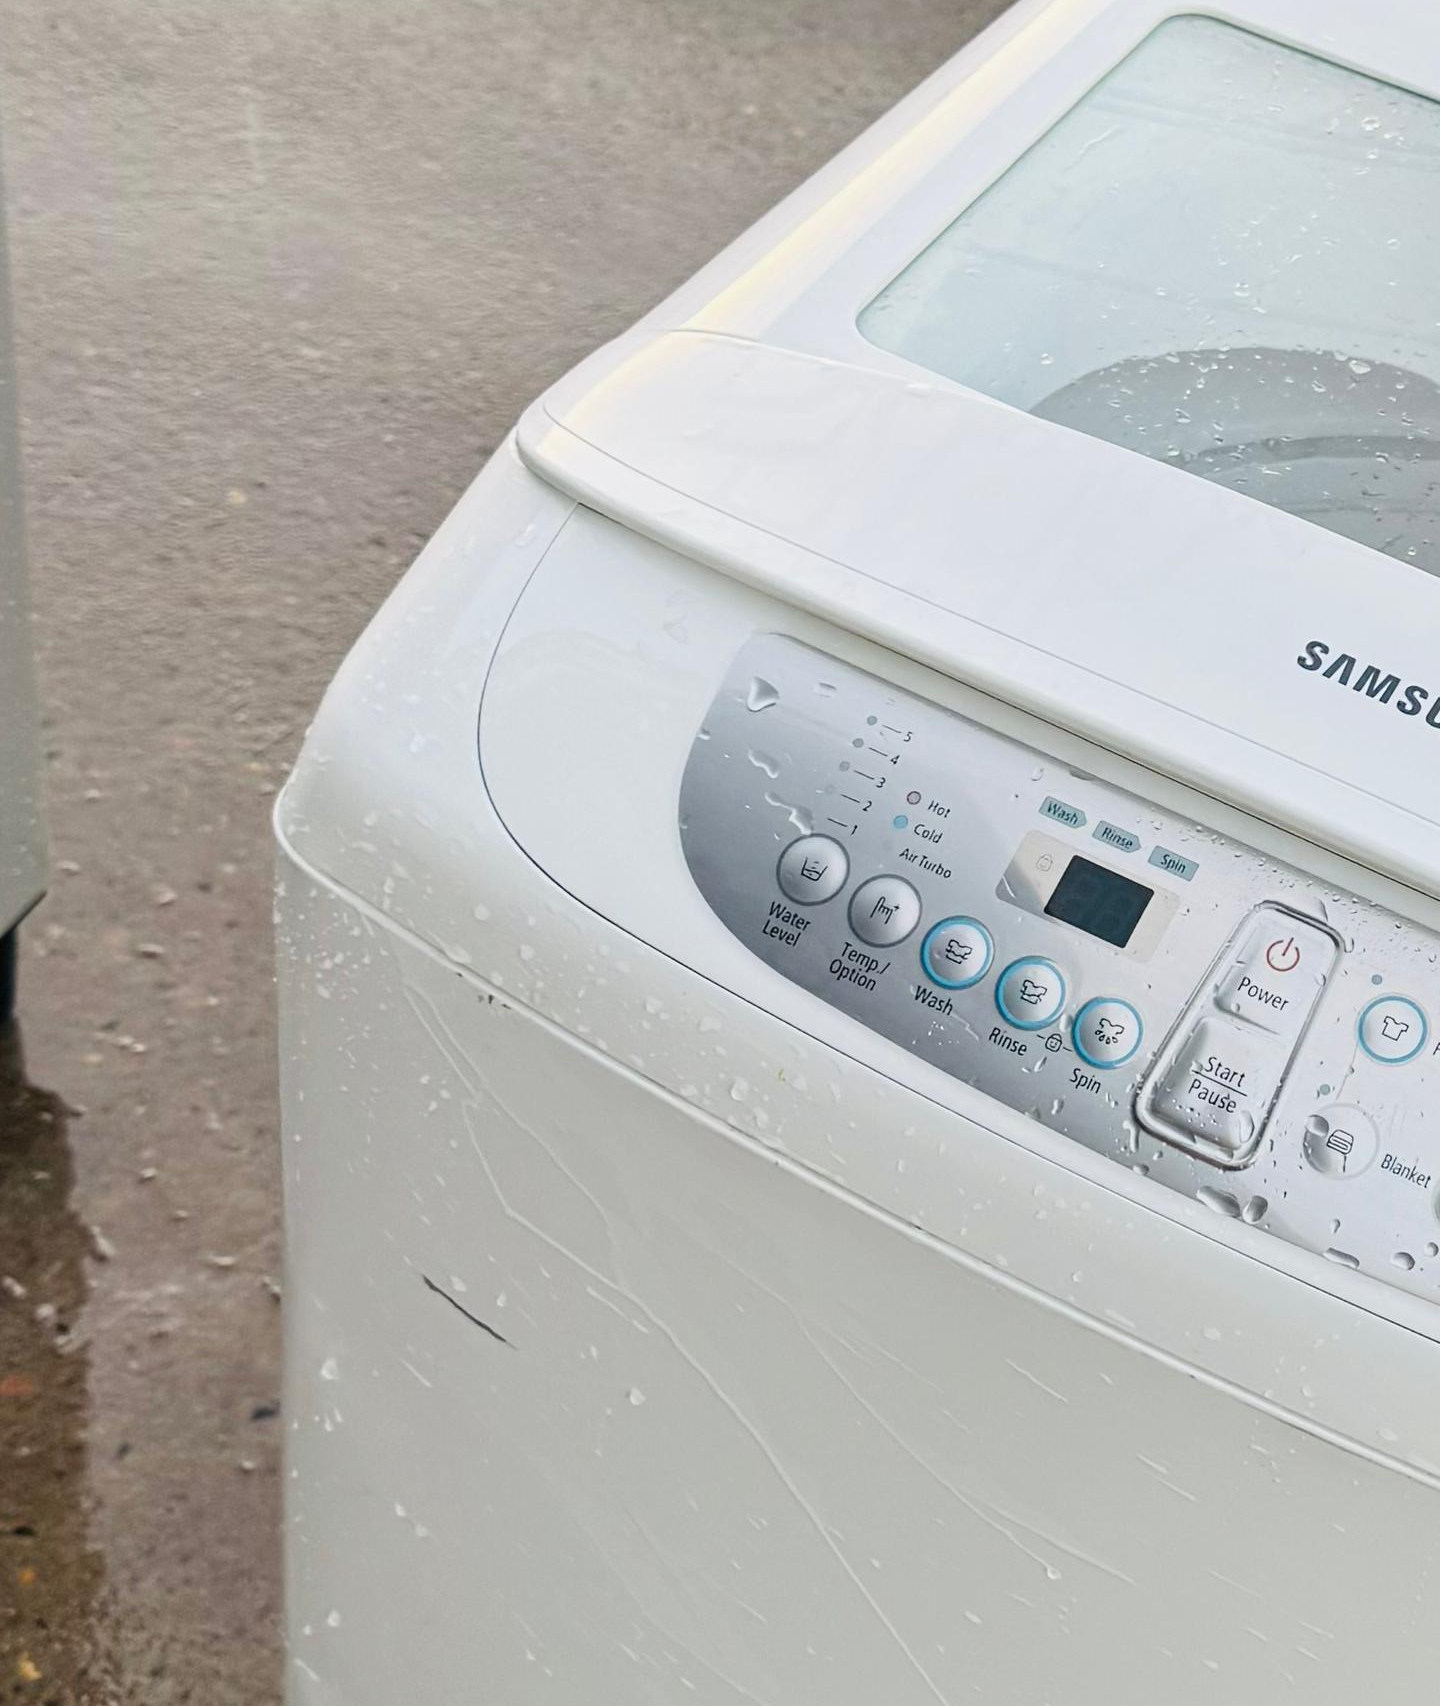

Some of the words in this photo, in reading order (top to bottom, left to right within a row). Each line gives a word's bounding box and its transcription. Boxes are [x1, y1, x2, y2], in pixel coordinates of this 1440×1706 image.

[903, 731, 914, 742] 5
[890, 755, 900, 765] 4
[876, 777, 886, 788] 3
[862, 800, 873, 812] 2
[928, 800, 951, 818] Hot
[1047, 802, 1079, 825] Wash
[851, 824, 858, 835] 1
[914, 823, 943, 844] Cold
[1102, 827, 1133, 849] Rinse
[899, 848, 918, 863] Air
[919, 856, 952, 879] Turbo
[1160, 854, 1186, 875] Spin
[768, 901, 811, 932] Water
[762, 919, 803, 948] Level
[842, 942, 891, 975] Temp./
[829, 960, 878, 992] Option
[914, 986, 954, 1016] Wash
[1237, 976, 1289, 1014] Power
[988, 1027, 1028, 1057] Rinse
[1069, 1067, 1102, 1095] Spin
[1204, 1053, 1246, 1091] Start
[1188, 1079, 1238, 1115] Pause
[1381, 1153, 1433, 1190] Blanket
